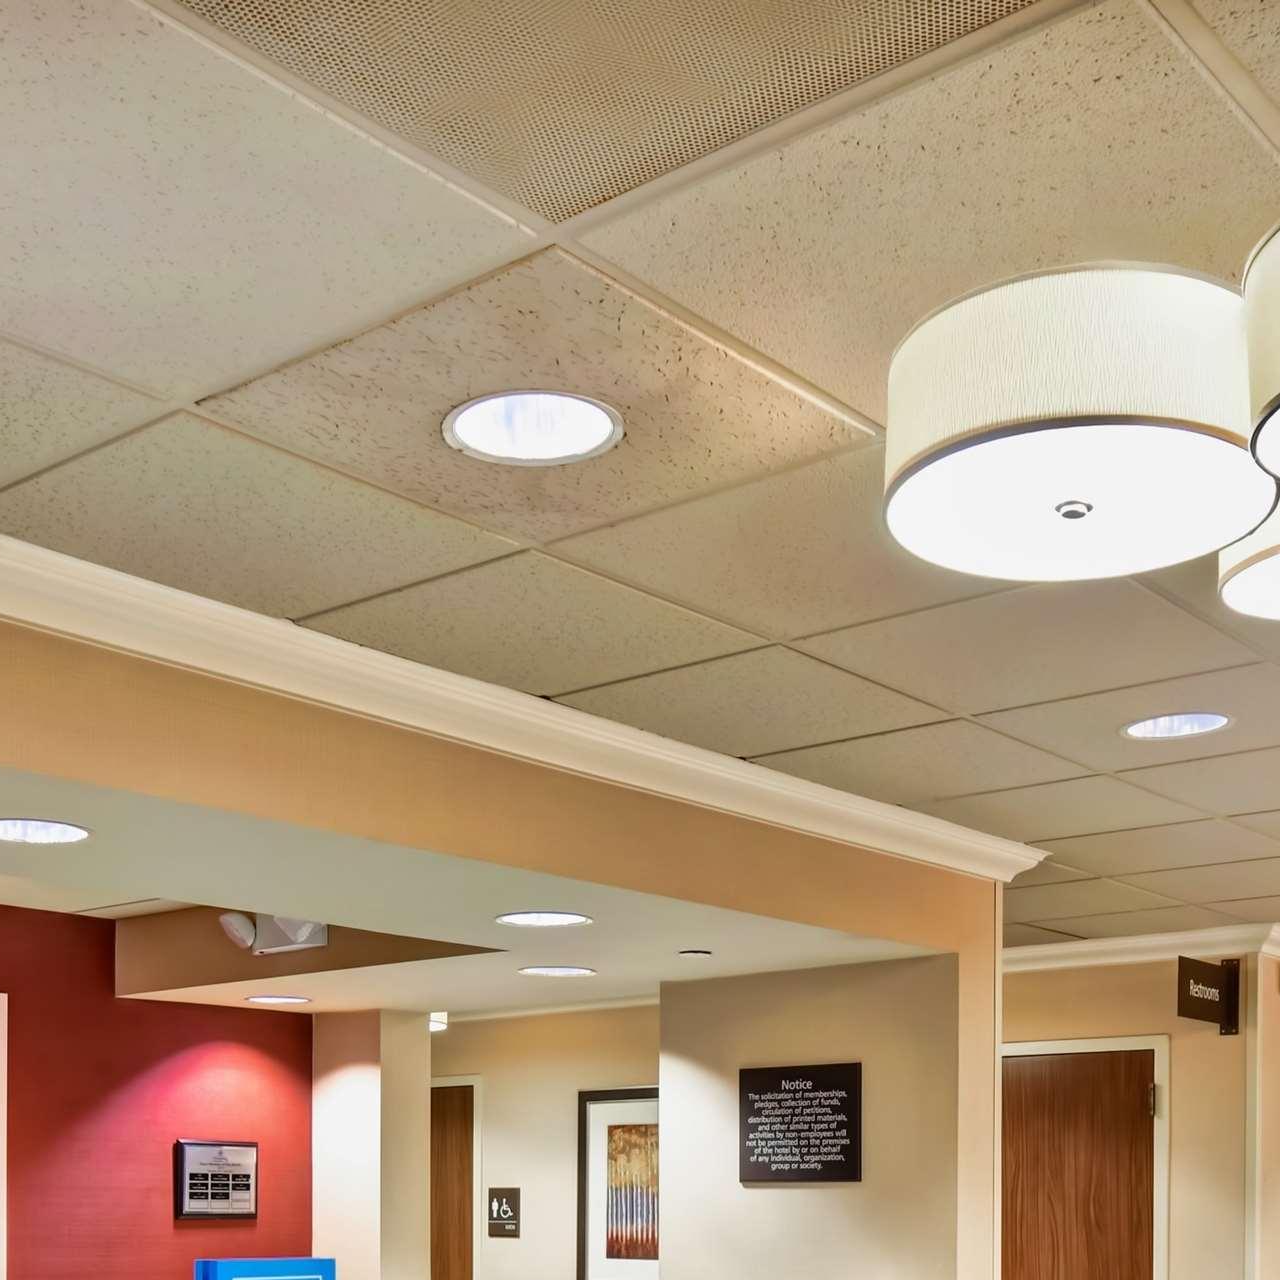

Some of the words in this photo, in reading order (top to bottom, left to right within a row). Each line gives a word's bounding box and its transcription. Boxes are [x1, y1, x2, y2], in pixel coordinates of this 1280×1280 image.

[1189, 979, 1220, 1002] Restrooms
[782, 1079, 812, 1090] Notice
[792, 1115, 815, 1123] printed
[811, 1122, 828, 1132] types
[792, 1147, 800, 1155] by
[771, 1162, 789, 1170] group
